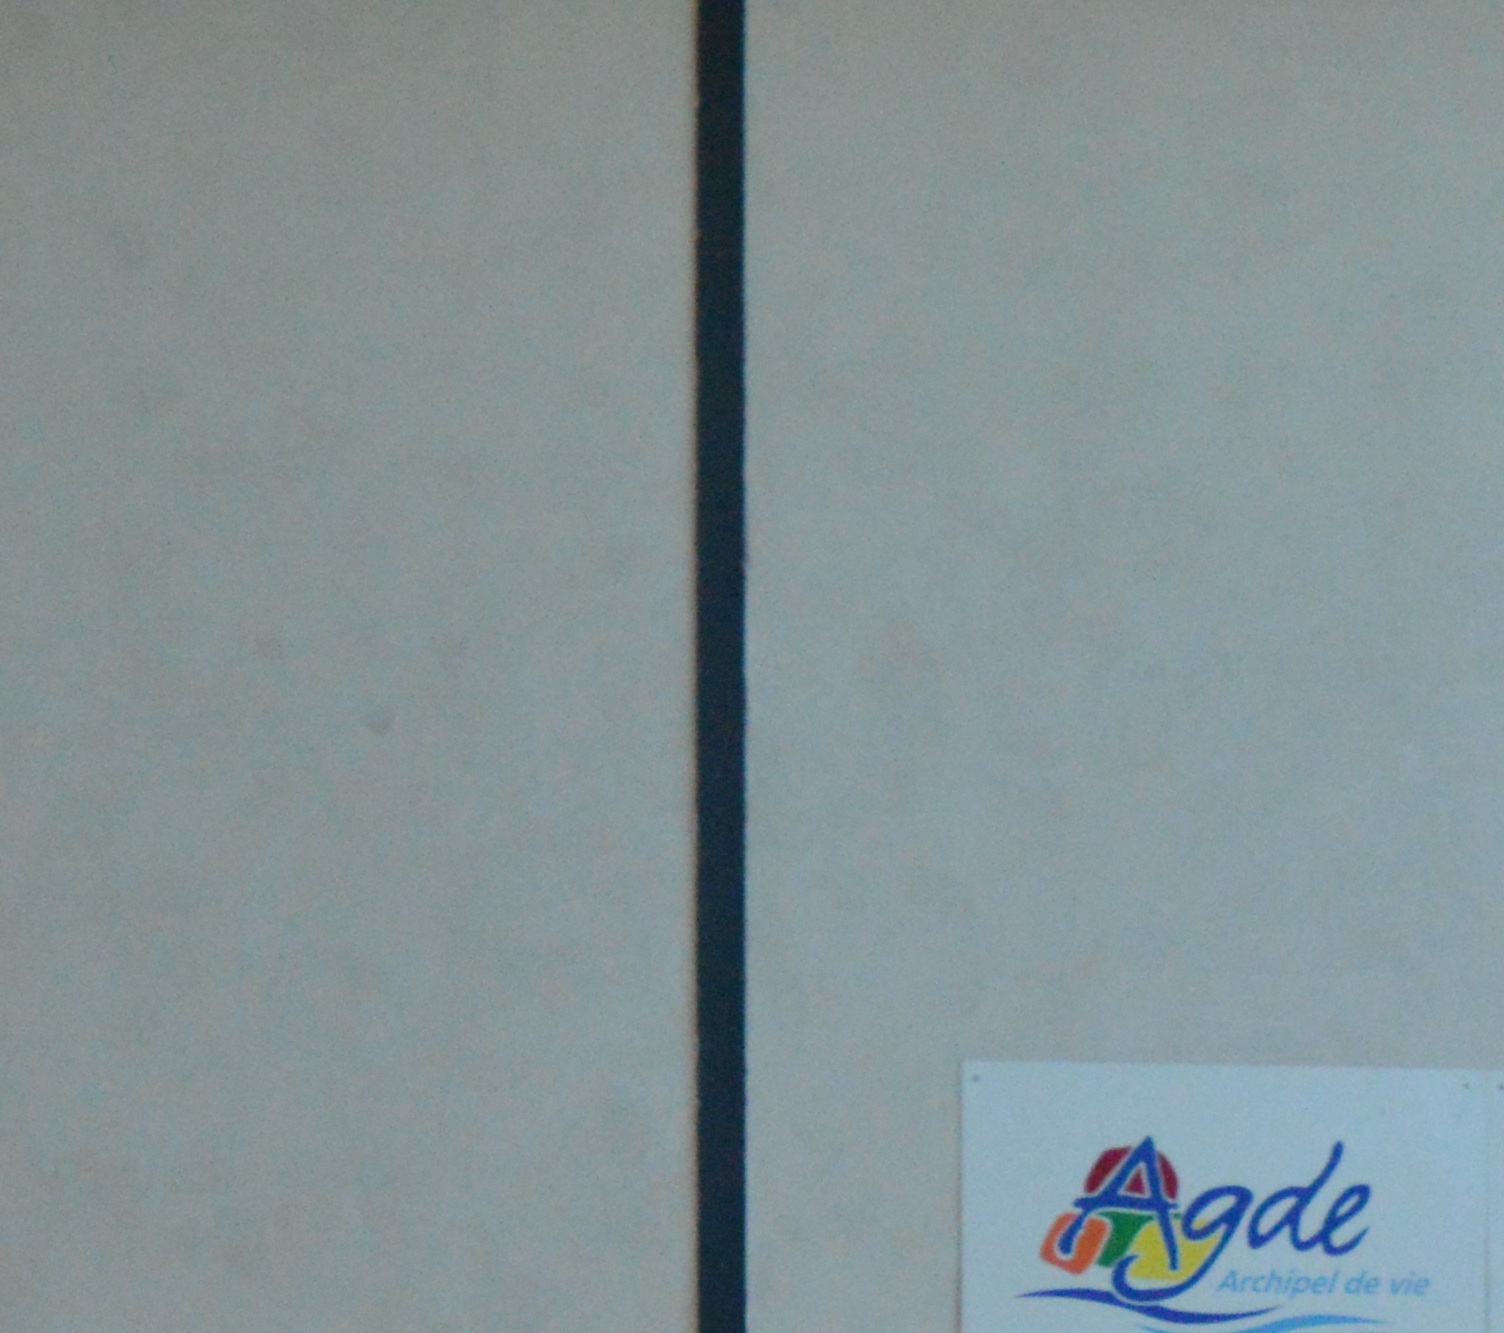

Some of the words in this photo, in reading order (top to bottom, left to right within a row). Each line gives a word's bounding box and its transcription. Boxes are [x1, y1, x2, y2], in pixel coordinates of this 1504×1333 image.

[1057, 1135, 1373, 1302] Agde
[1217, 1269, 1337, 1300] Archipel
[1344, 1270, 1380, 1296] de
[1389, 1272, 1432, 1297] vie
